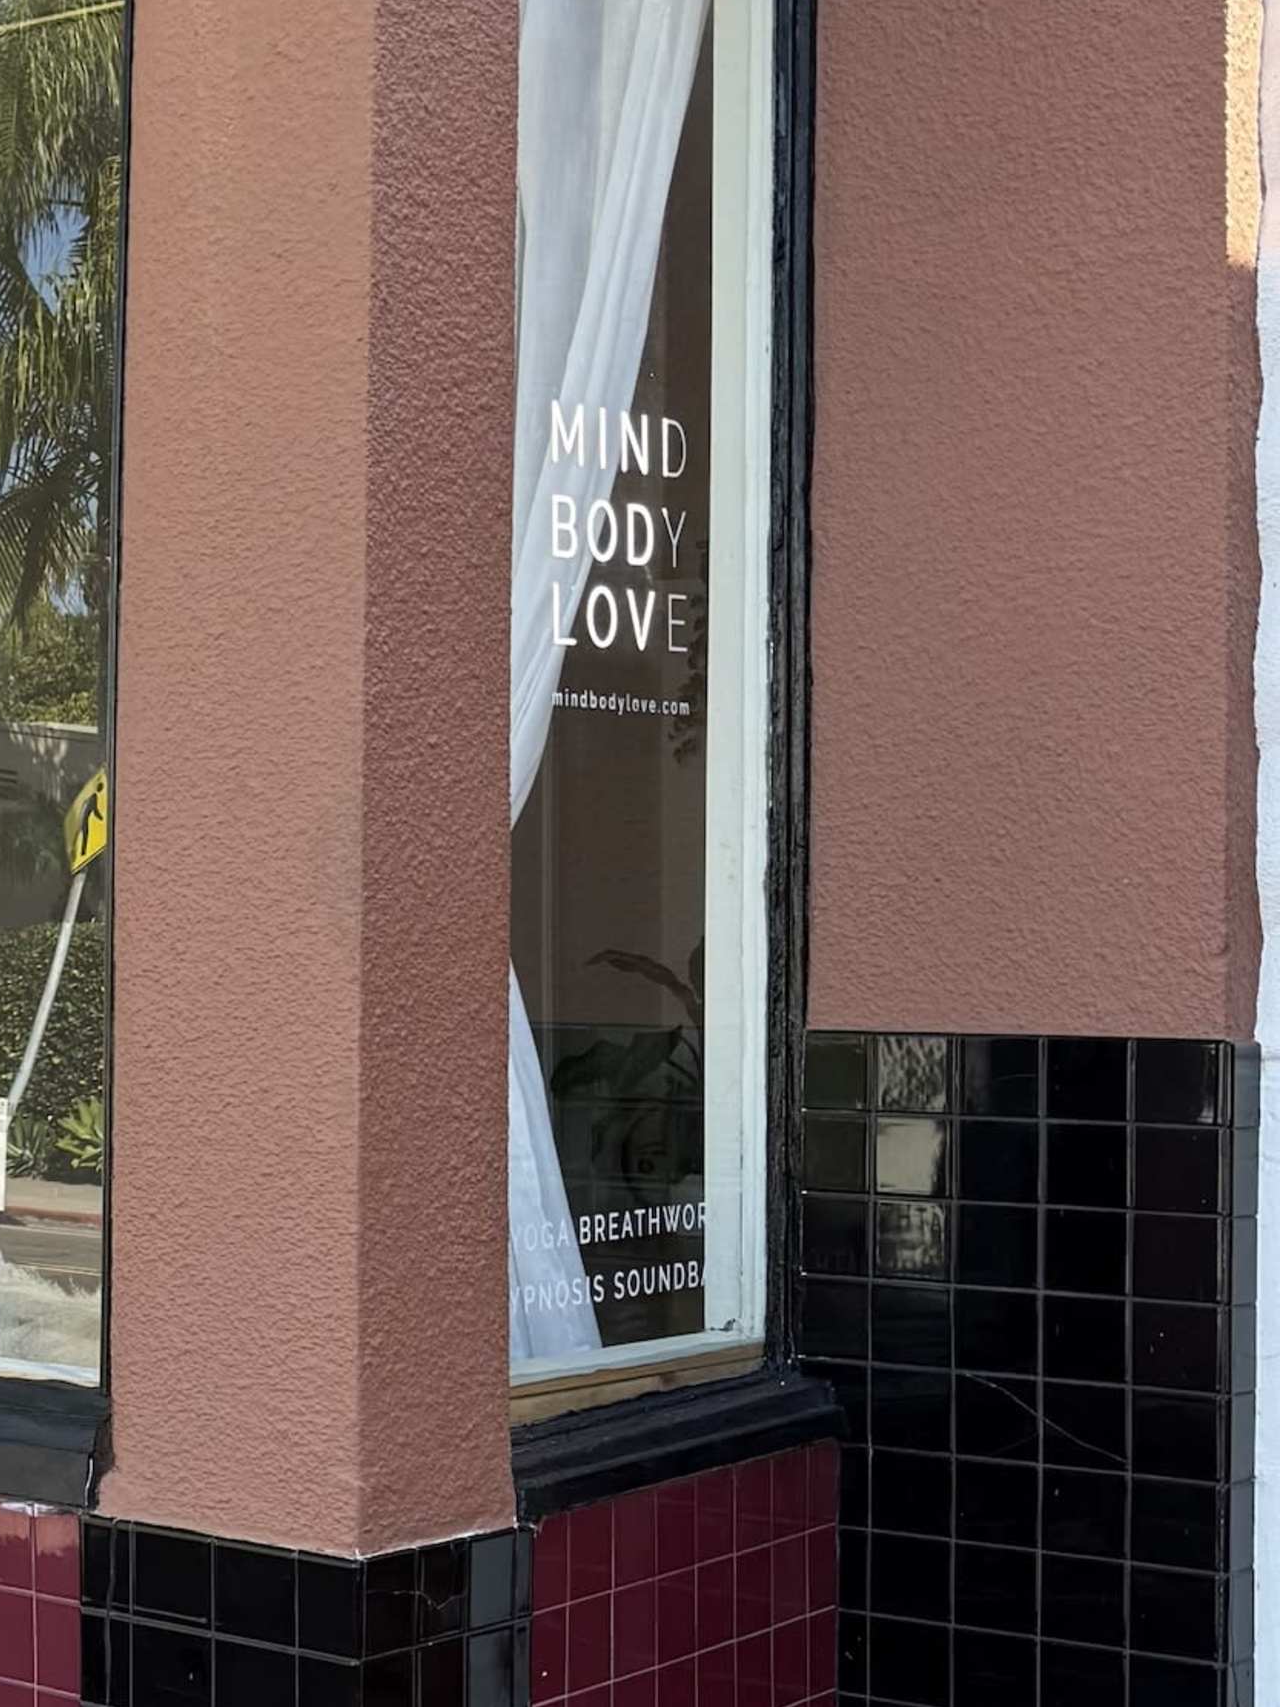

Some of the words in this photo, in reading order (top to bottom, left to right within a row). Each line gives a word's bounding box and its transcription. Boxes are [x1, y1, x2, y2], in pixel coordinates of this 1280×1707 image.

[550, 399, 687, 478] MIND
[551, 494, 687, 569] BODY
[552, 581, 688, 653] LOVE
[551, 688, 691, 717] mindbodylove.com
[511, 1220, 572, 1253] YOGA
[510, 1274, 605, 1314] YPNOSIS
